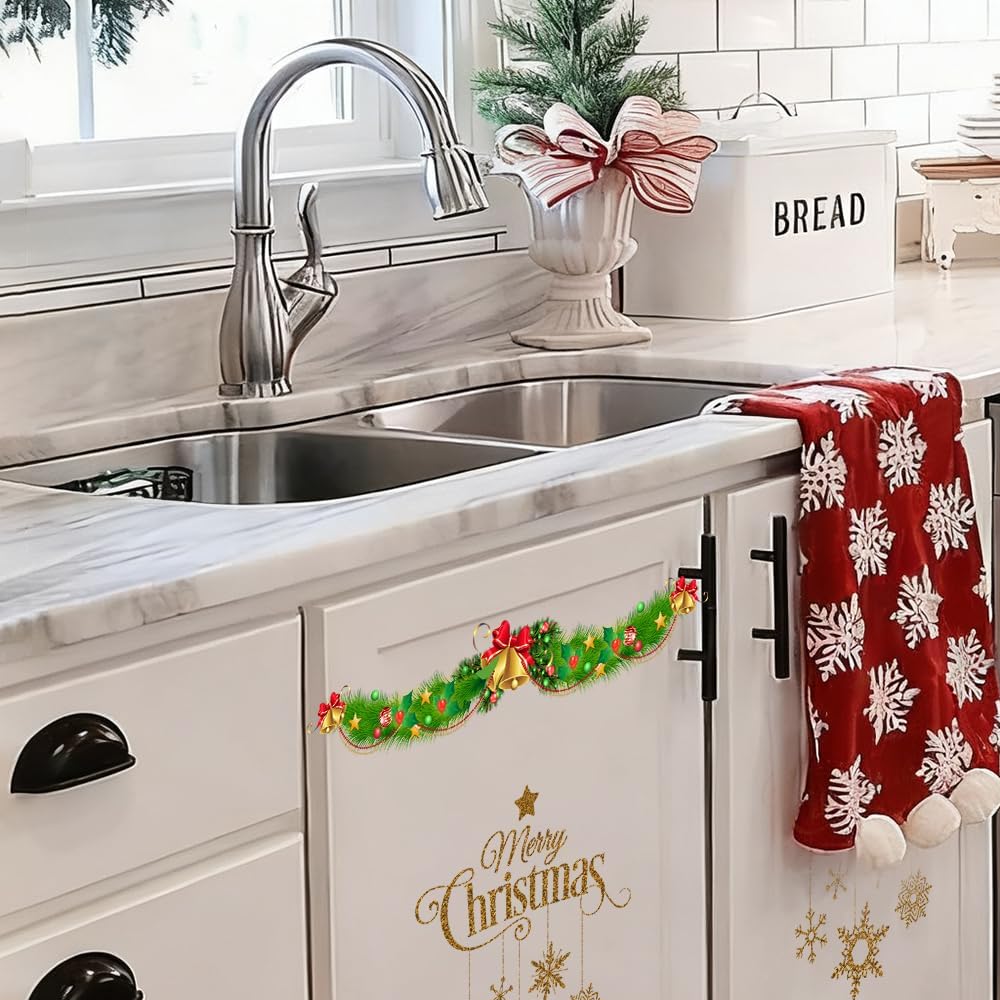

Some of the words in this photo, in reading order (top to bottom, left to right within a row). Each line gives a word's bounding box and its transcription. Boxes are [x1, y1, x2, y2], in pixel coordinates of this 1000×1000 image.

[774, 192, 866, 237] BREAD
[480, 824, 568, 873] Merry
[414, 852, 632, 952] Christmas
